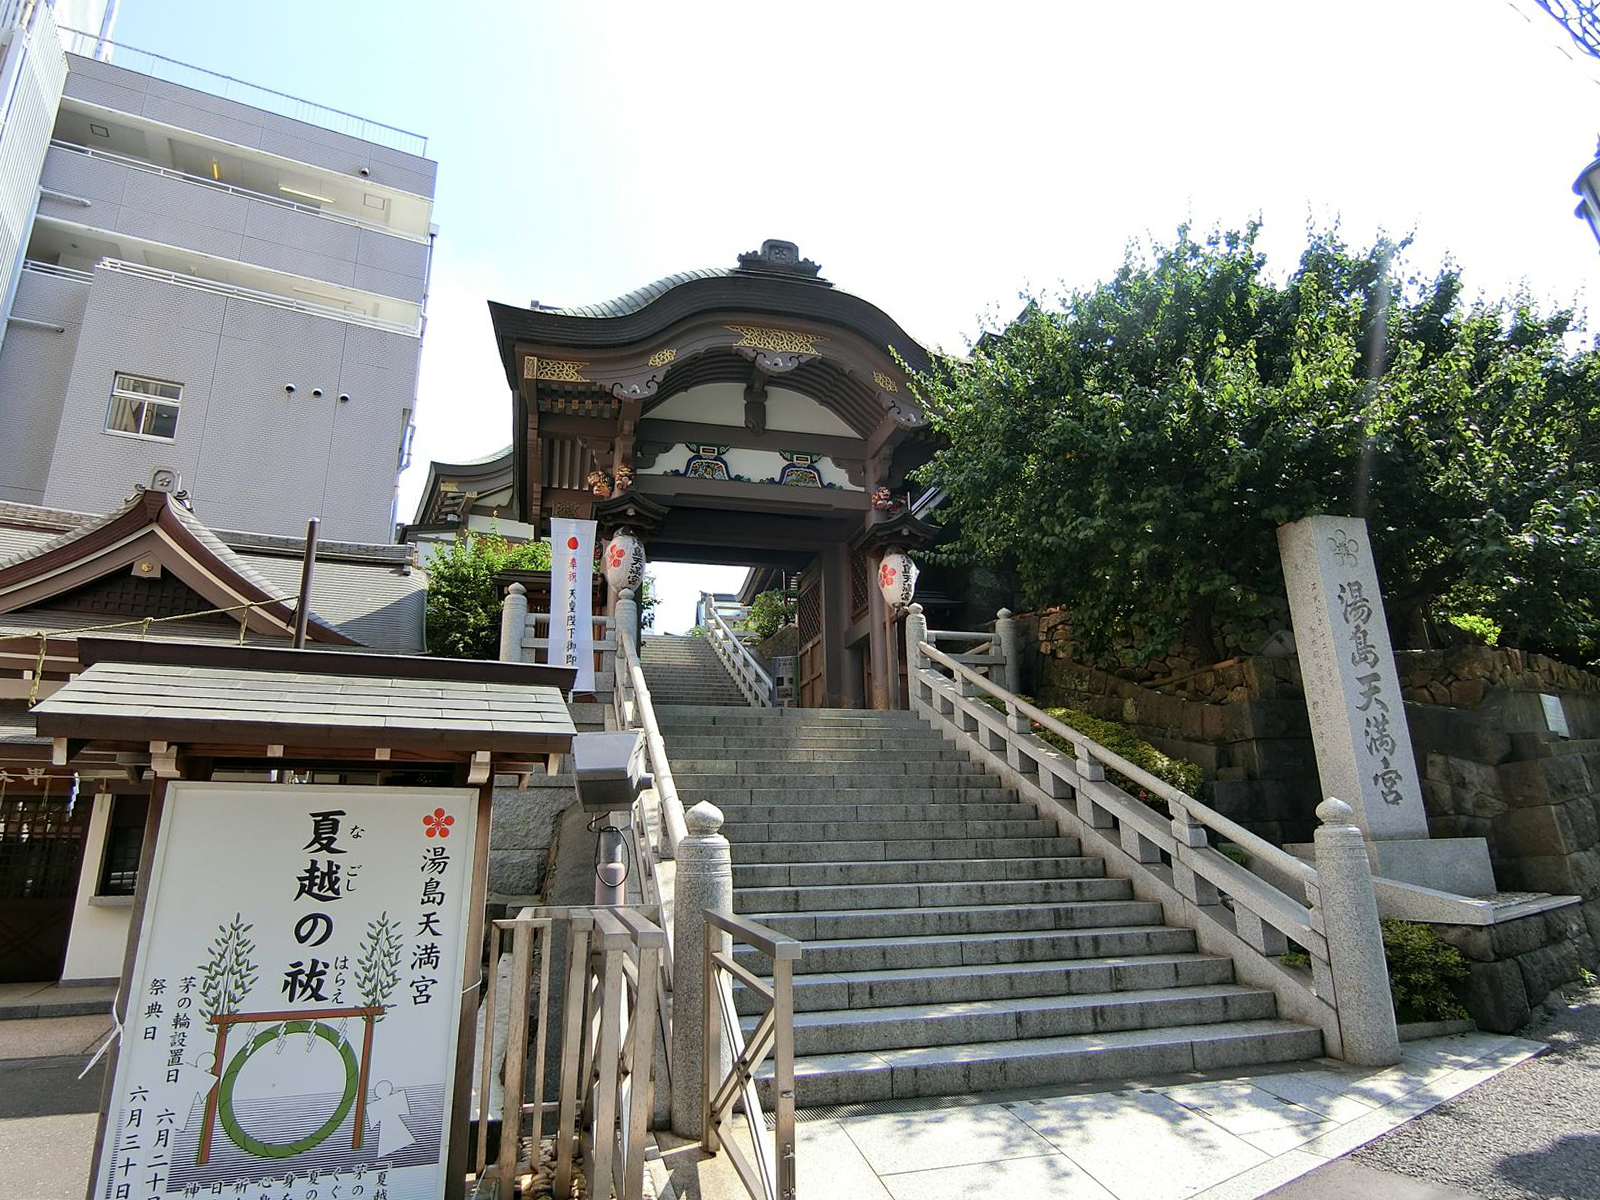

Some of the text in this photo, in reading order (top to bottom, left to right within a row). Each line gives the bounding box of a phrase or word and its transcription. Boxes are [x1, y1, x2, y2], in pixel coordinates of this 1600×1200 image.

[568, 558, 577, 583] 奉祝
[1337, 580, 1404, 806] 湯島天満宮
[281, 810, 348, 1003] 夏越の祓
[332, 956, 349, 1004] はらえ
[409, 846, 450, 1006] 湯島天満宮
[116, 978, 167, 1200] 祭典日 六月三十日
[166, 976, 196, 1083] 茅の輪設置日
